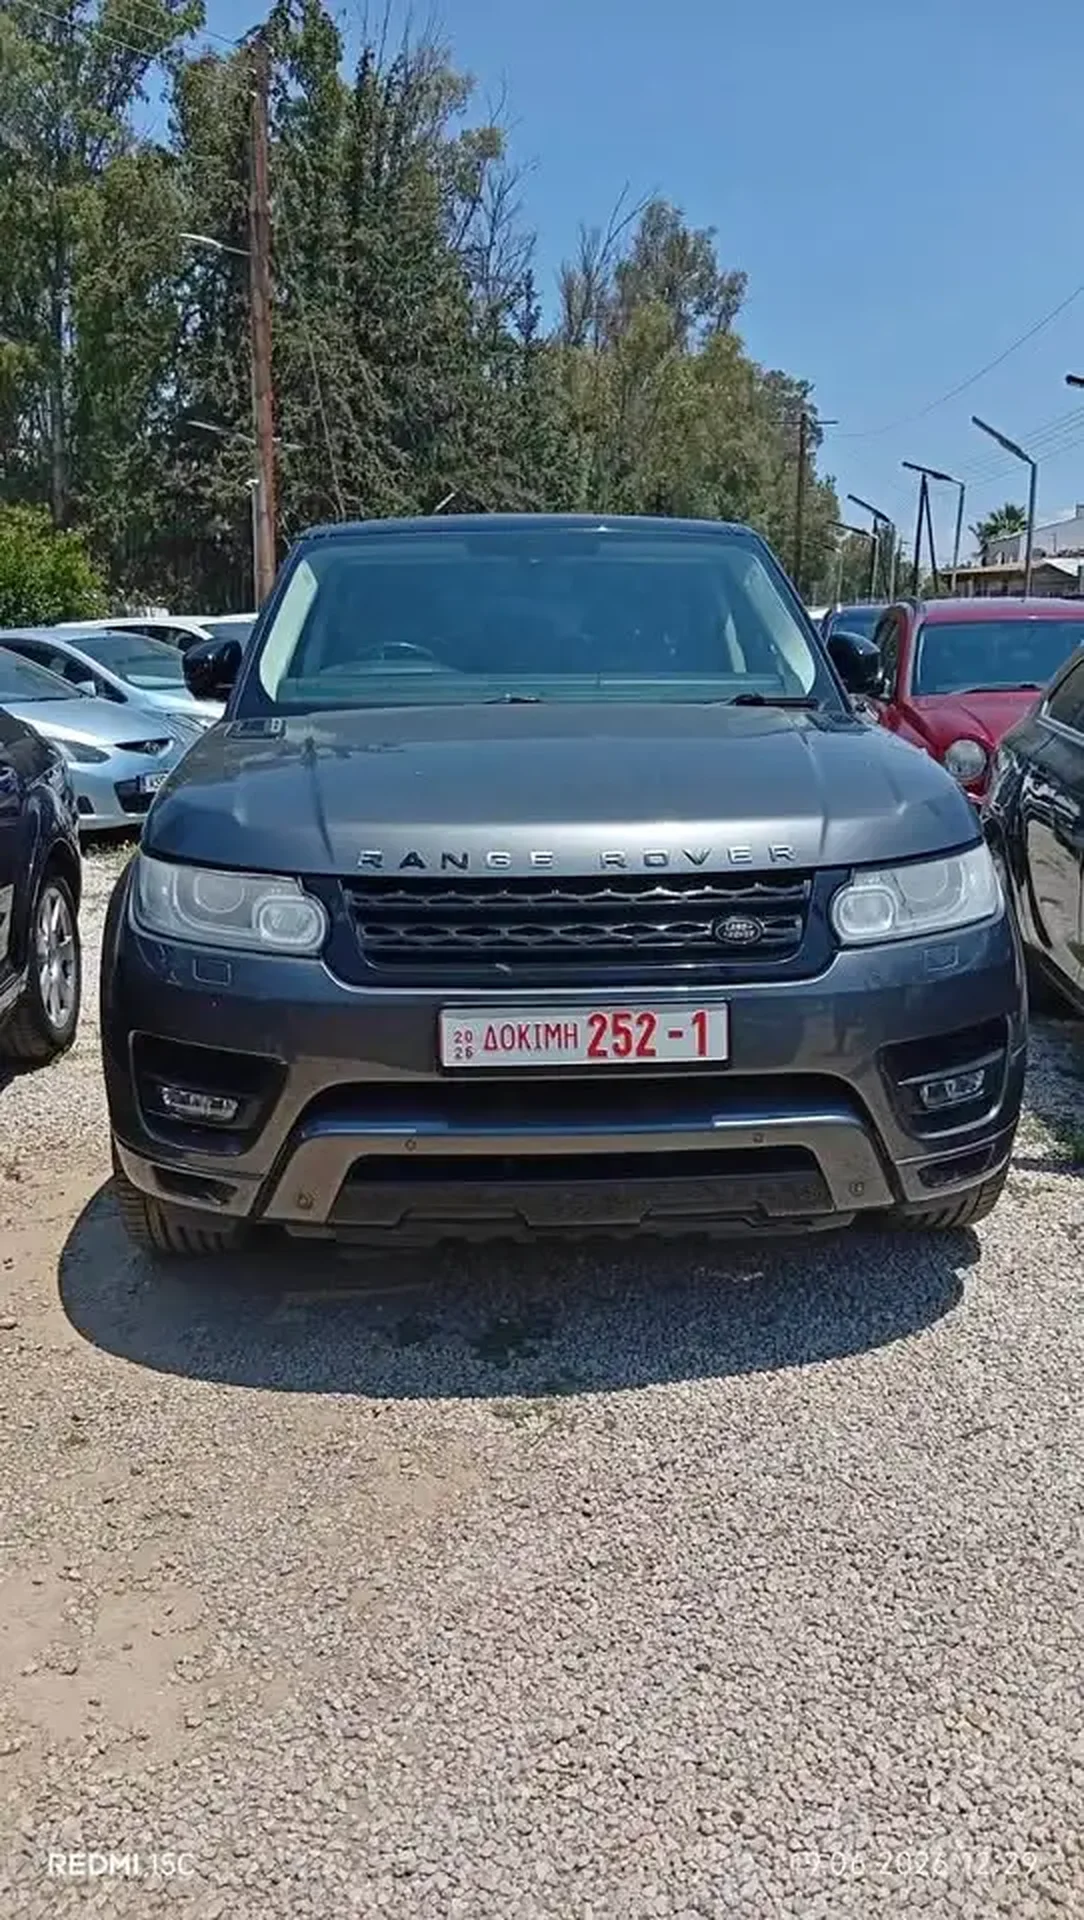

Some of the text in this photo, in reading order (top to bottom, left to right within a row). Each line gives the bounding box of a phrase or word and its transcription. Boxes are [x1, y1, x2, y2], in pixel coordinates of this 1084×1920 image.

[357, 845, 797, 871] RANGE ROVER
[453, 1030, 473, 1044] 20
[483, 1023, 578, 1051] ΔΟΚΙΜΗ
[453, 1046, 473, 1059] 26
